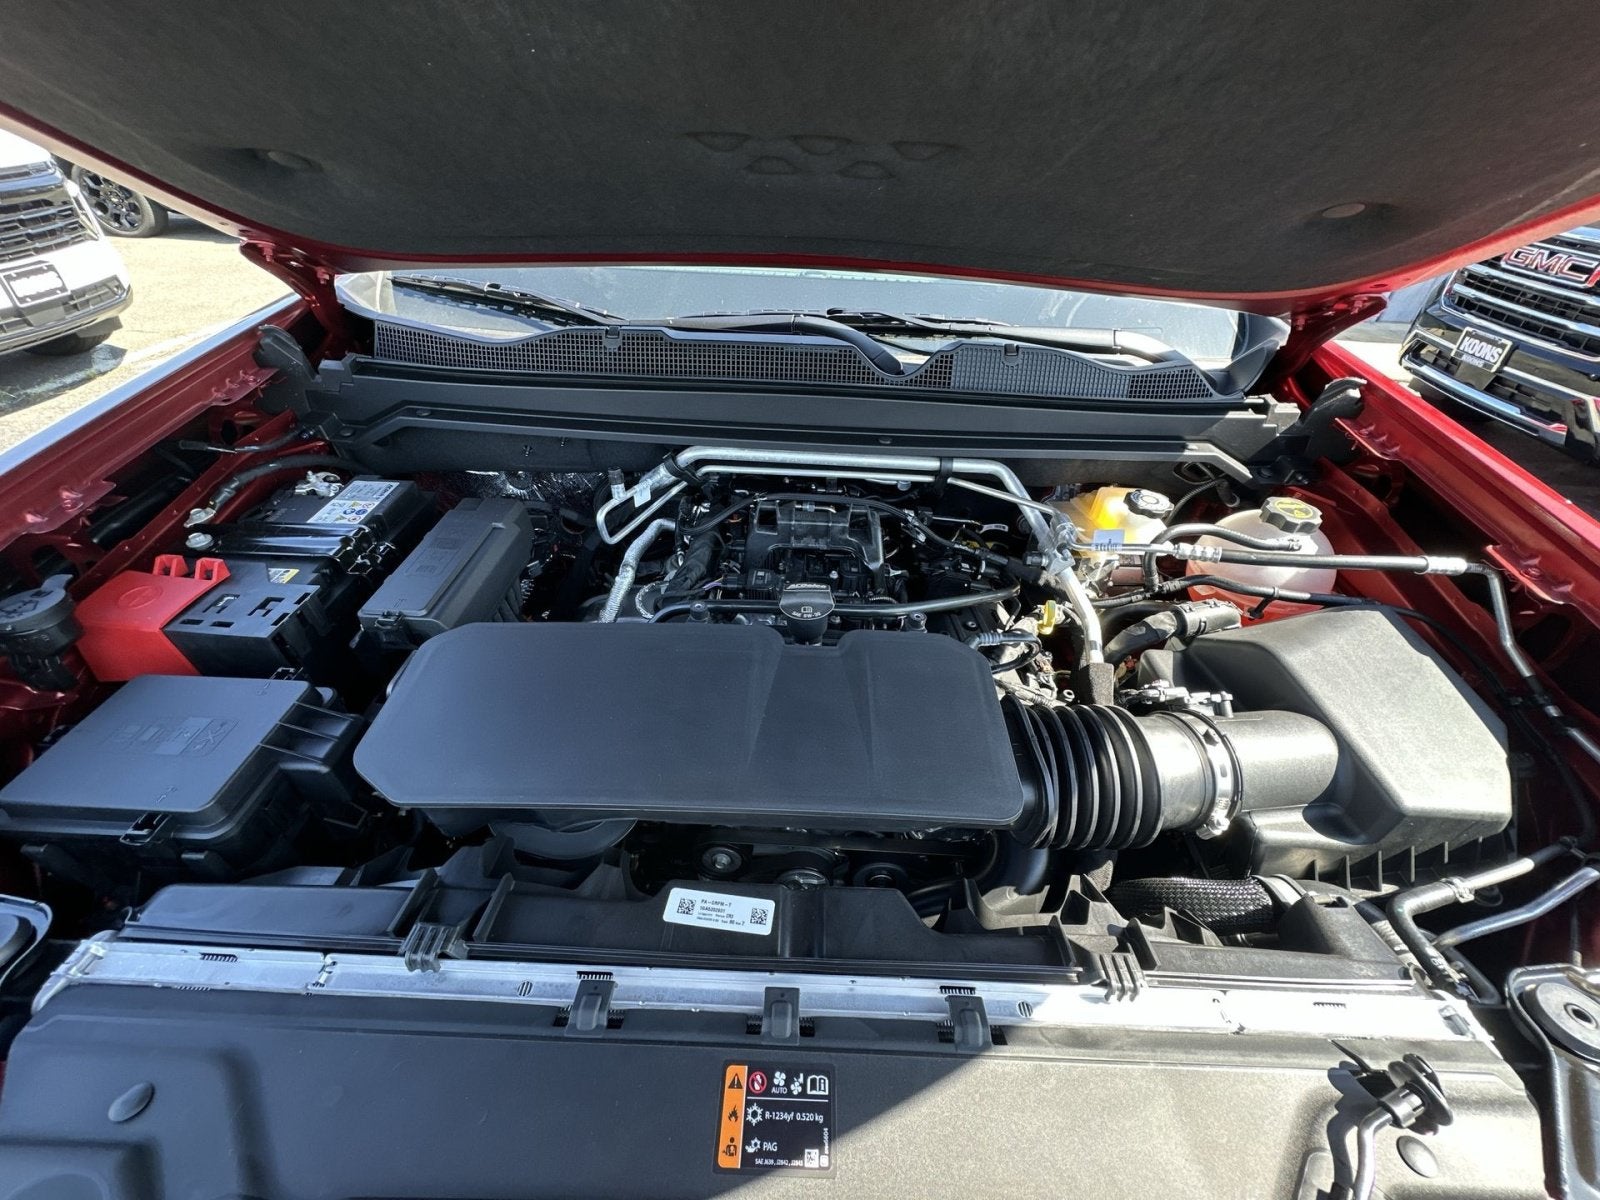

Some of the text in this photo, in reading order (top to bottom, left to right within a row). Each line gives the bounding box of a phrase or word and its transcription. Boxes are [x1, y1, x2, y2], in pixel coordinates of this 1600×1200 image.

[1506, 246, 1596, 282] GMC
[1459, 336, 1503, 363] KOONS
[765, 1111, 824, 1123] R-1234yf 0.520 kg
[763, 1142, 778, 1152] PAG
